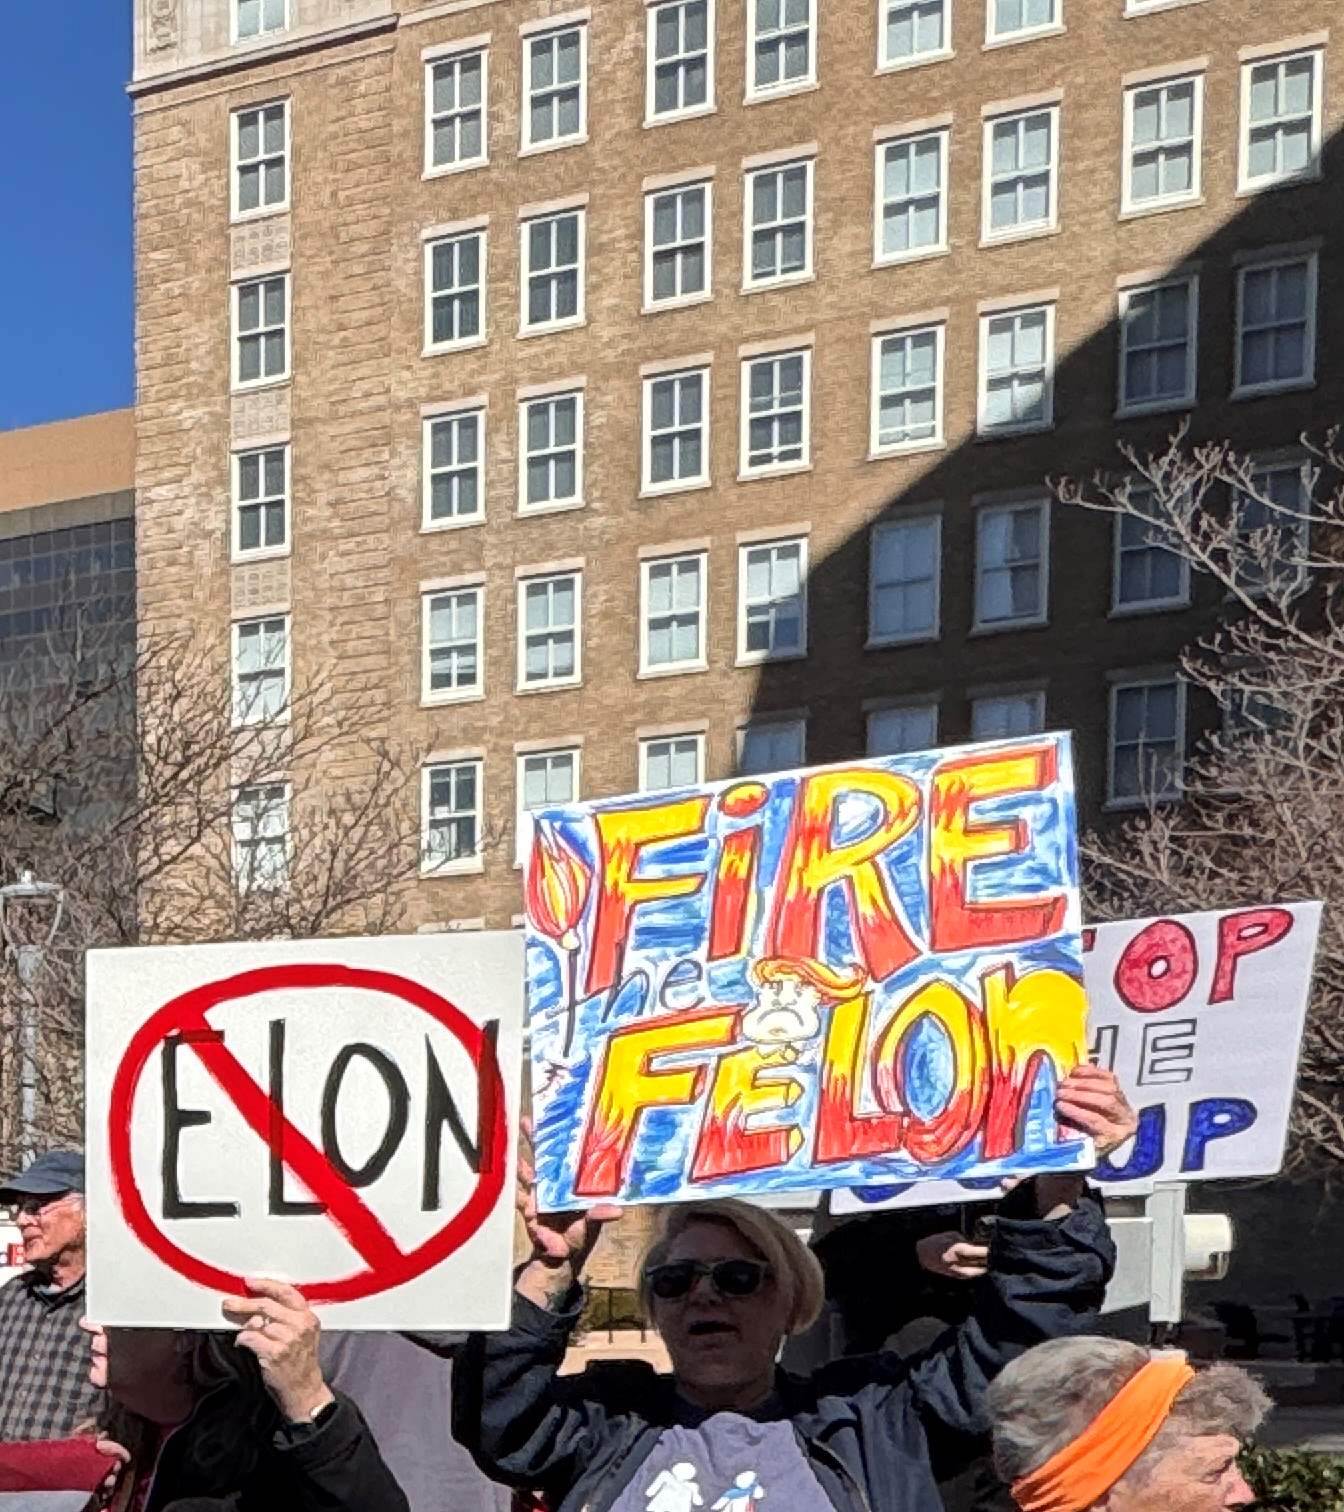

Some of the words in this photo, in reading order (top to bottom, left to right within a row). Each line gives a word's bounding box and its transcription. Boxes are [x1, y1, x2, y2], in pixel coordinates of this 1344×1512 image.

[1082, 906, 1295, 1014] OP
[161, 1018, 501, 1220] ELON
[1086, 1097, 1258, 1183] UP
